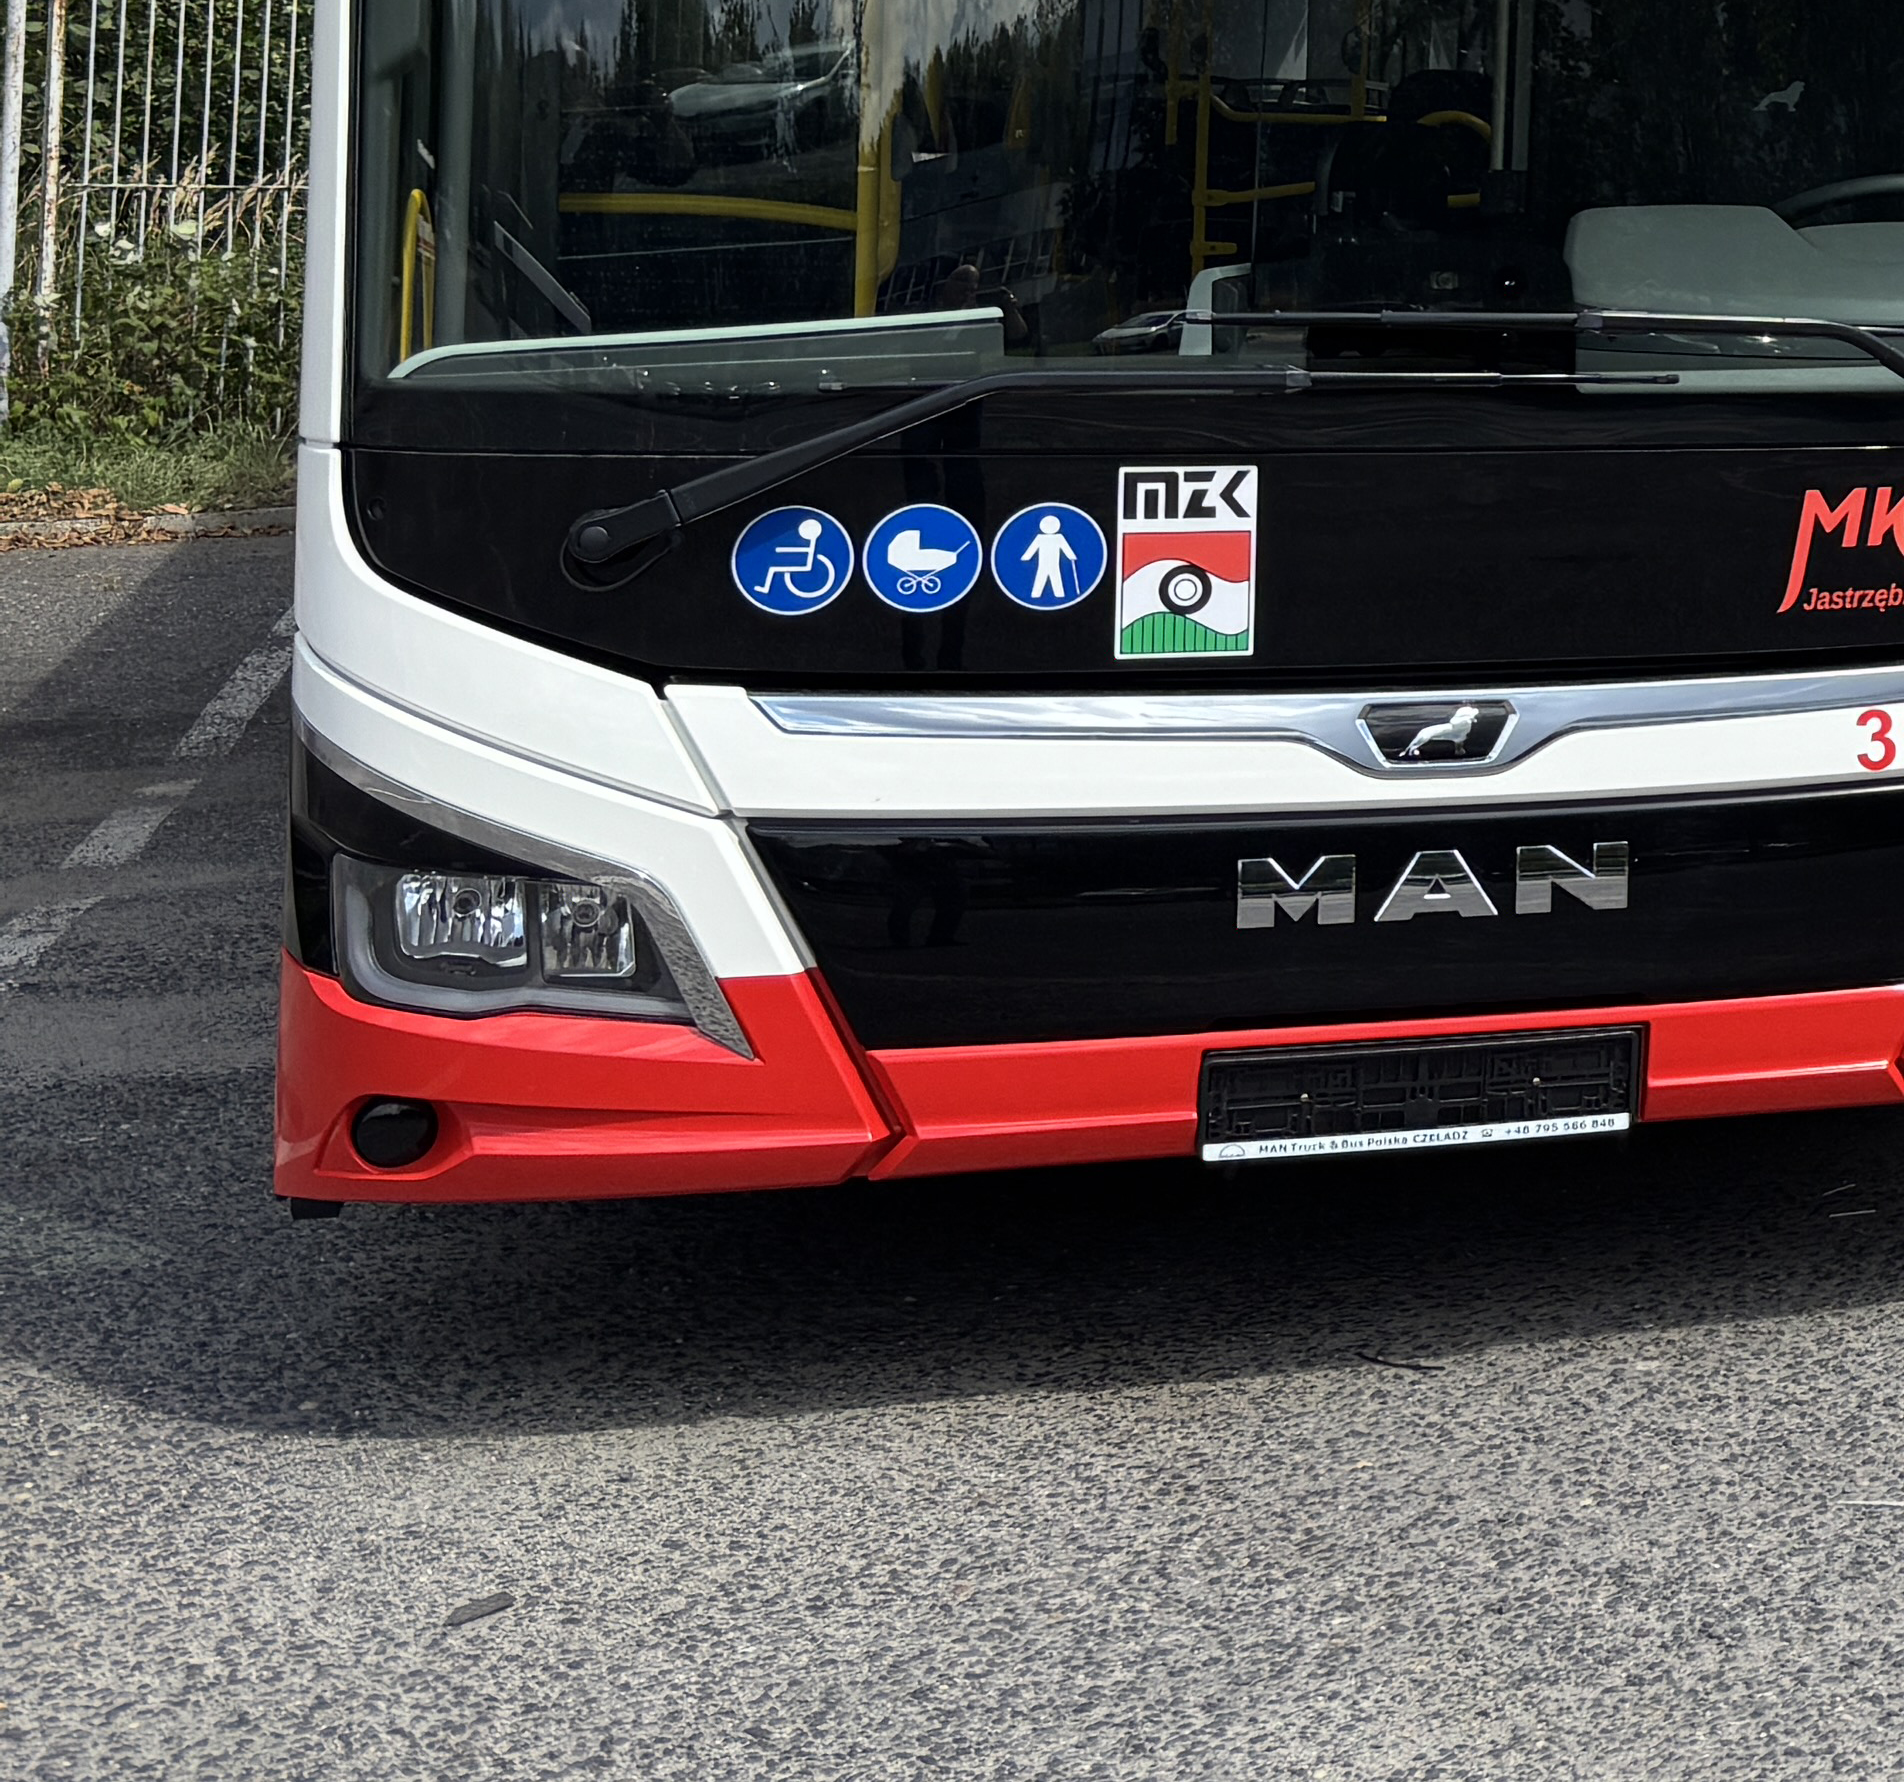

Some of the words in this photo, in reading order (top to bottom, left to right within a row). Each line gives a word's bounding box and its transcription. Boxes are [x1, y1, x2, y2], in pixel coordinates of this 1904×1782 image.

[1123, 470, 1251, 520] MZK
[1237, 840, 1630, 929] MAN
[1259, 1143, 1287, 1154] MAN
